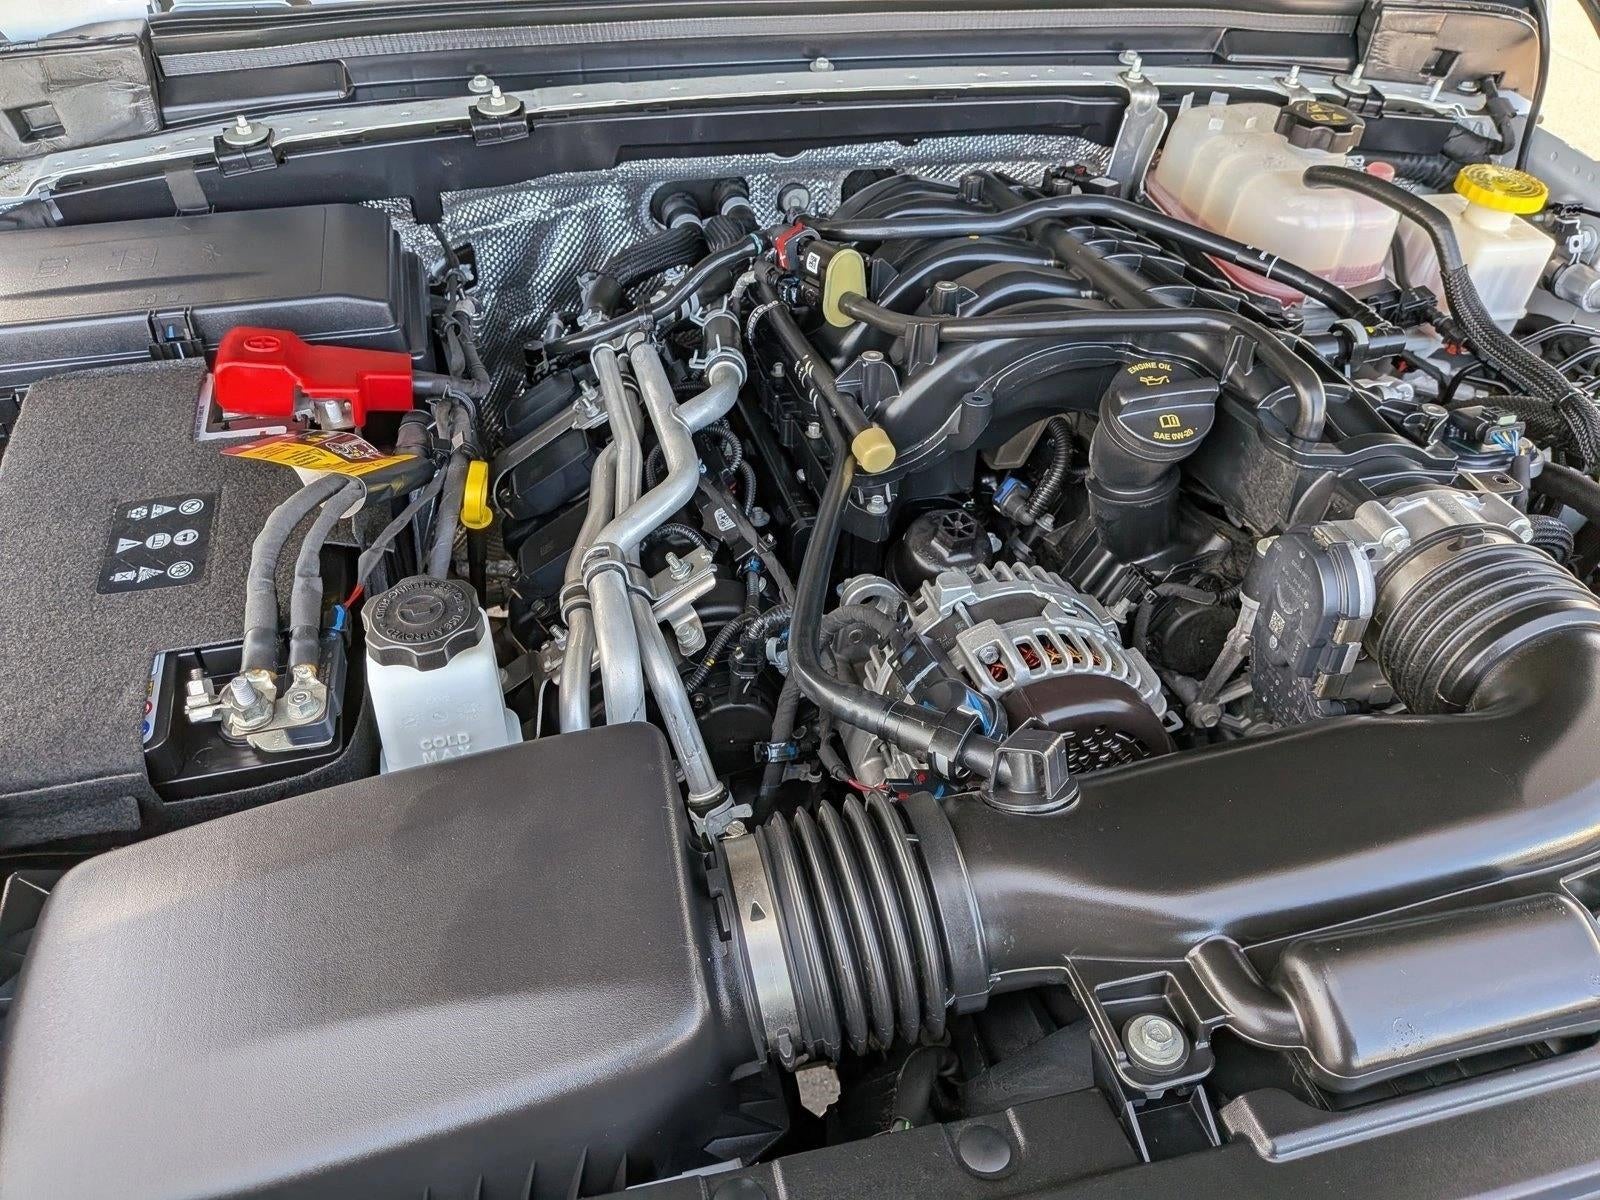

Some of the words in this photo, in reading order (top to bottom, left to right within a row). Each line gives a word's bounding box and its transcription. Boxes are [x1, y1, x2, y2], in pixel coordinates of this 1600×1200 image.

[1127, 362, 1157, 374] ENGINE
[1158, 362, 1172, 371] OIL
[1153, 431, 1171, 440] SAE
[1171, 428, 1194, 440] 0W-20
[420, 732, 471, 752] COLD
